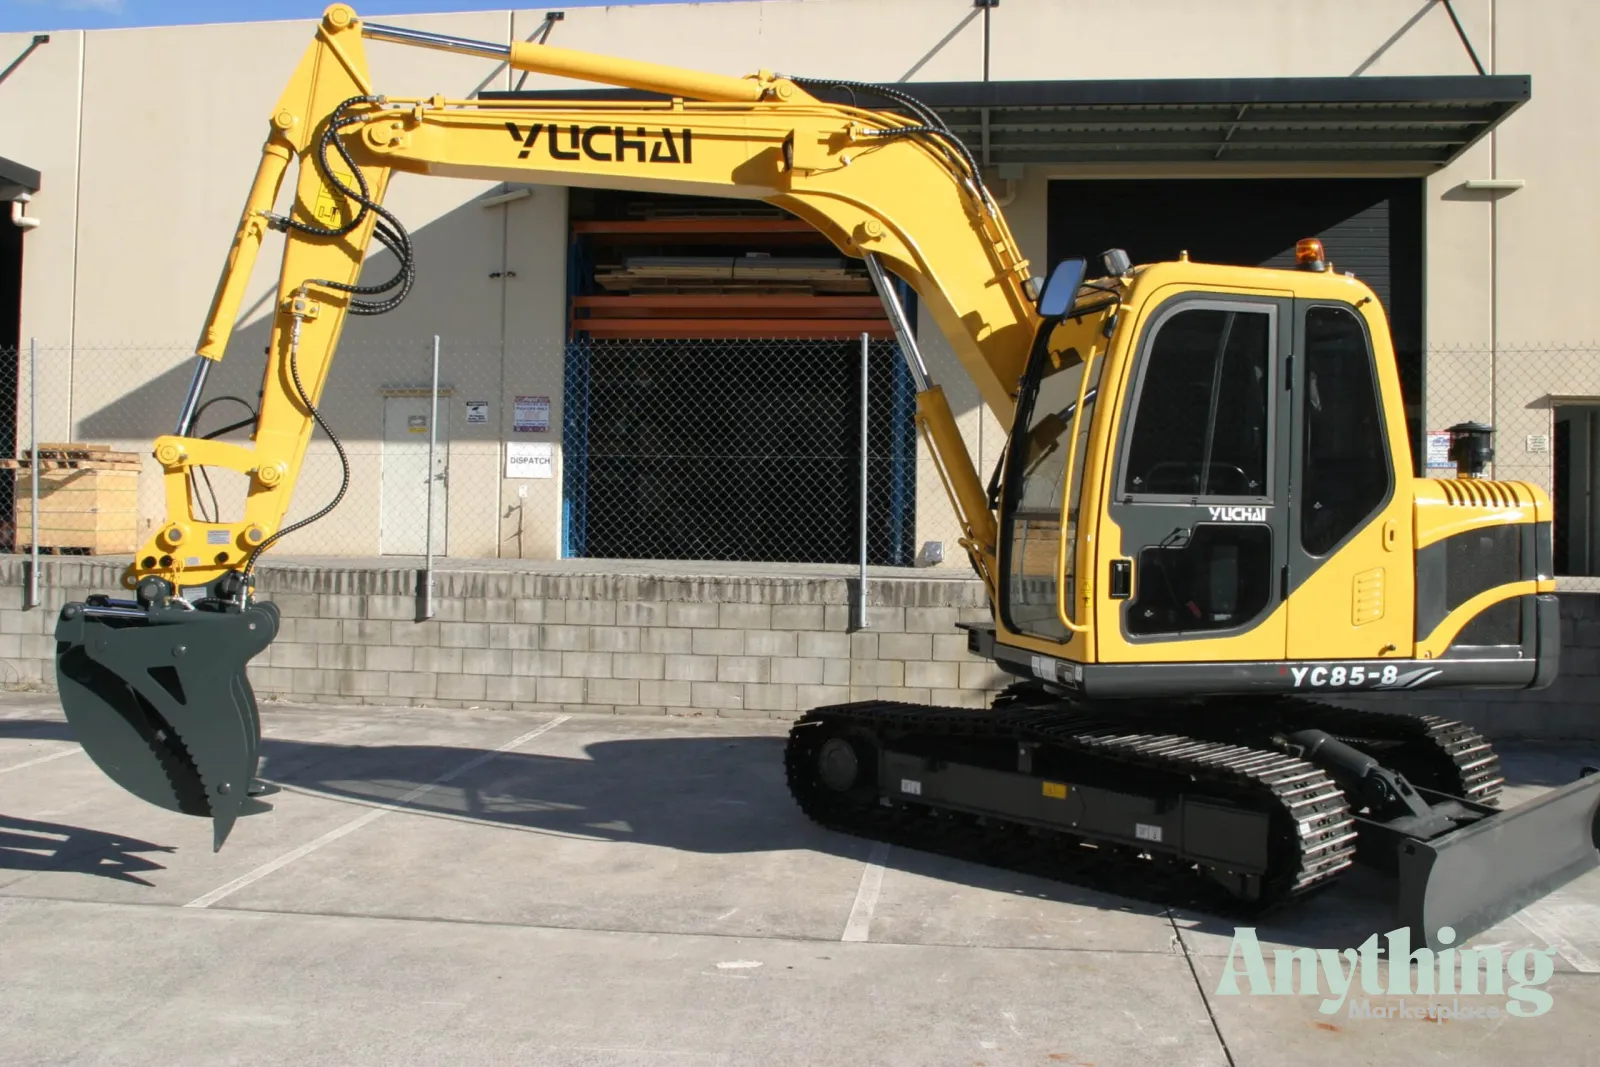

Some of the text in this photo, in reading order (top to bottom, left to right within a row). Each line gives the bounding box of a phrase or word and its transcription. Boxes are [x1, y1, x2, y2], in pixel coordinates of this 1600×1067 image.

[505, 122, 692, 164] YUCHAI
[510, 456, 551, 465] DISPATCH
[1208, 507, 1266, 521] YUCHAI
[1290, 665, 1399, 687] YC85-8
